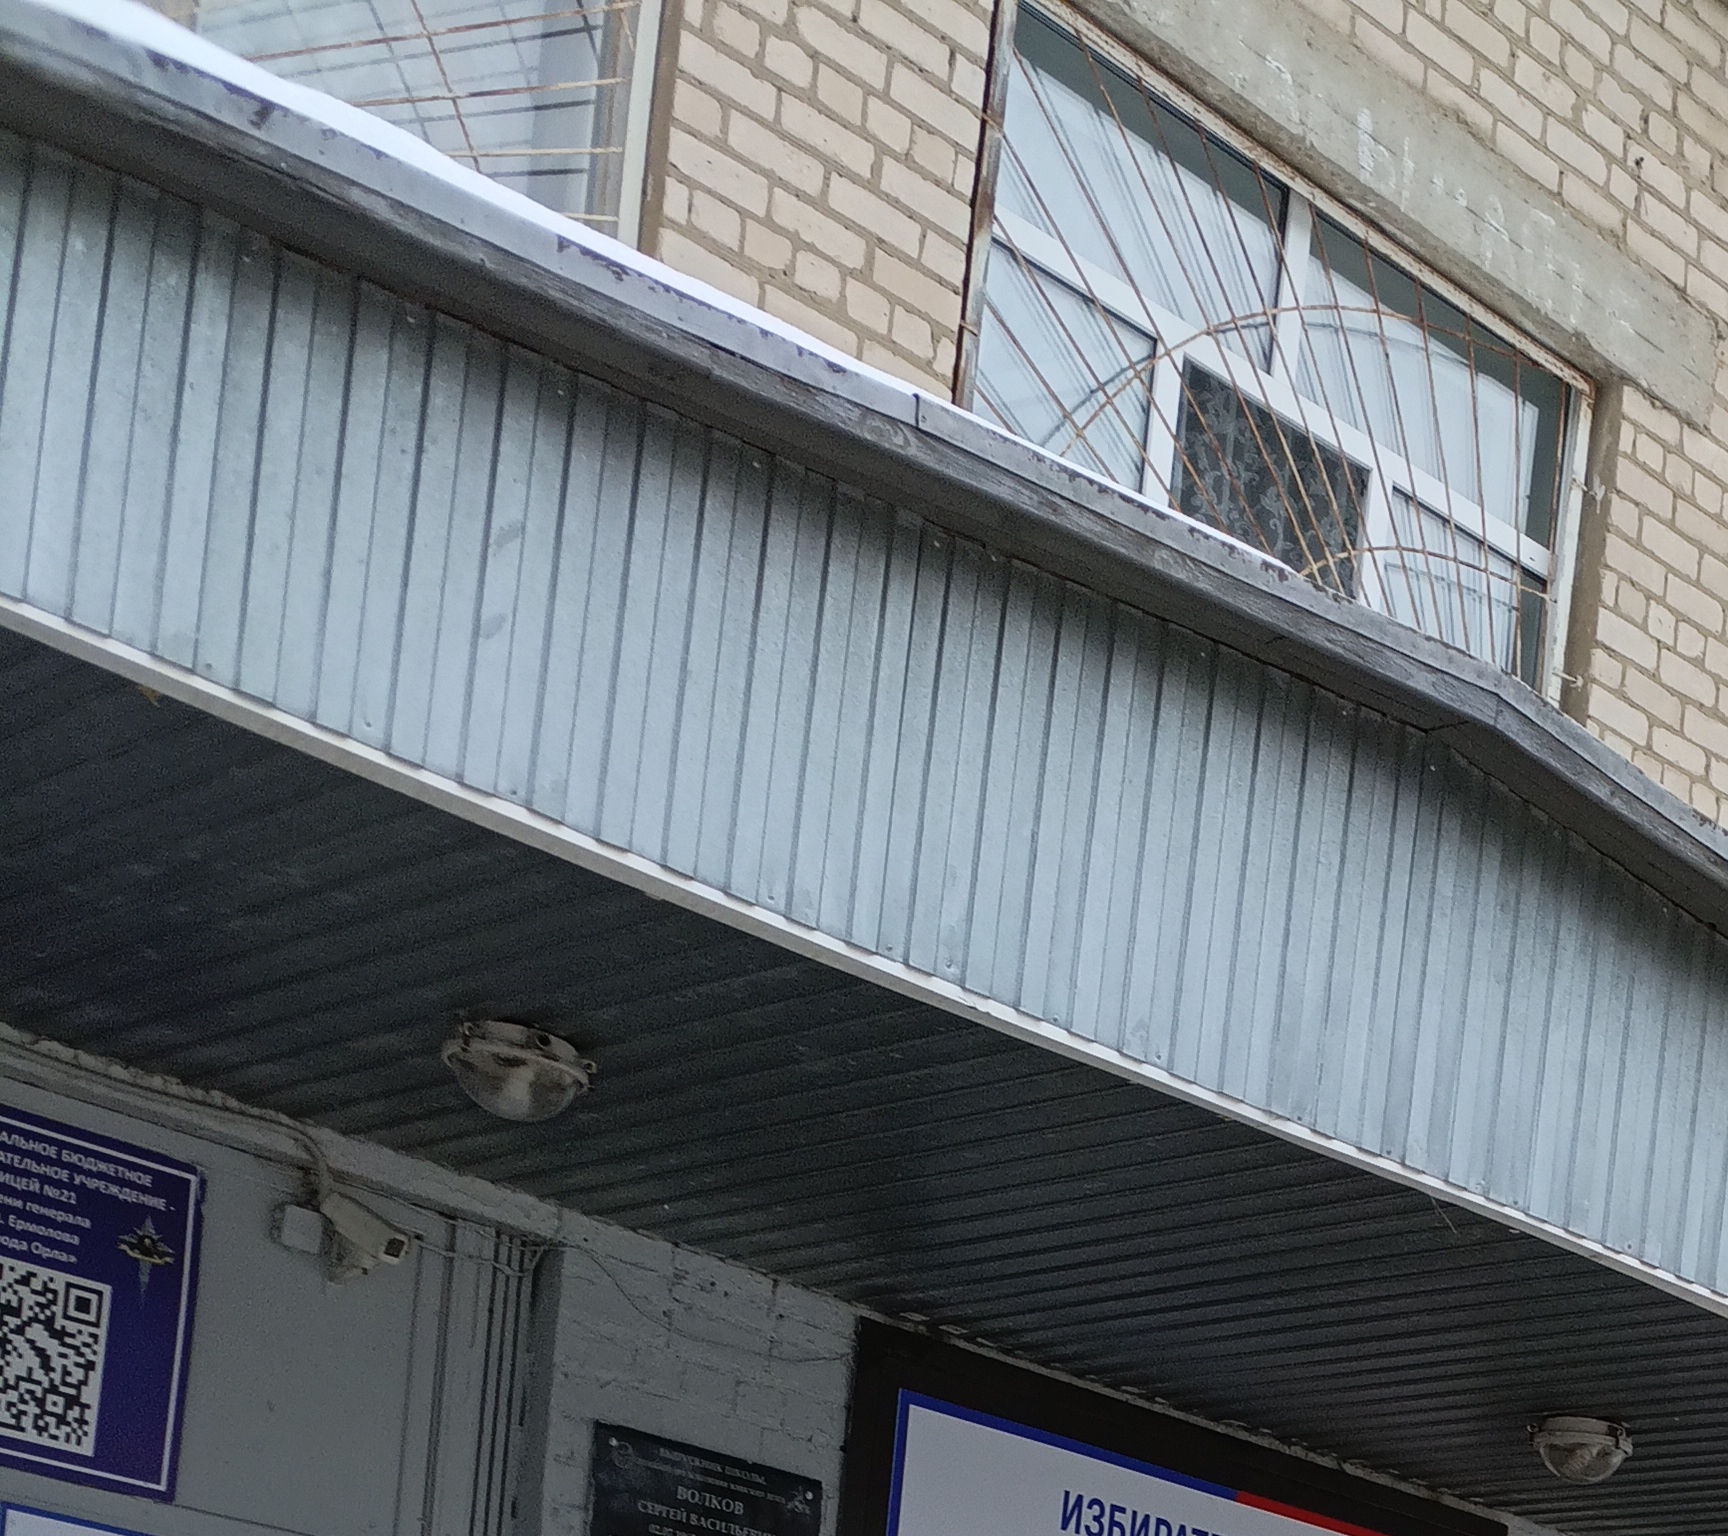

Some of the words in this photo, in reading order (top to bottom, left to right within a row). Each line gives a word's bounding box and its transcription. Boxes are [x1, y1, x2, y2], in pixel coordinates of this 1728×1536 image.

[61, 1149, 153, 1188] БЮДЖЕТНОЕ
[8, 1214, 80, 1246] Ермолова
[26, 1201, 92, 1229] генерала
[637, 1500, 688, 1524] СЕРГЕЙ
[677, 1485, 745, 1516] ВОЛКОВ
